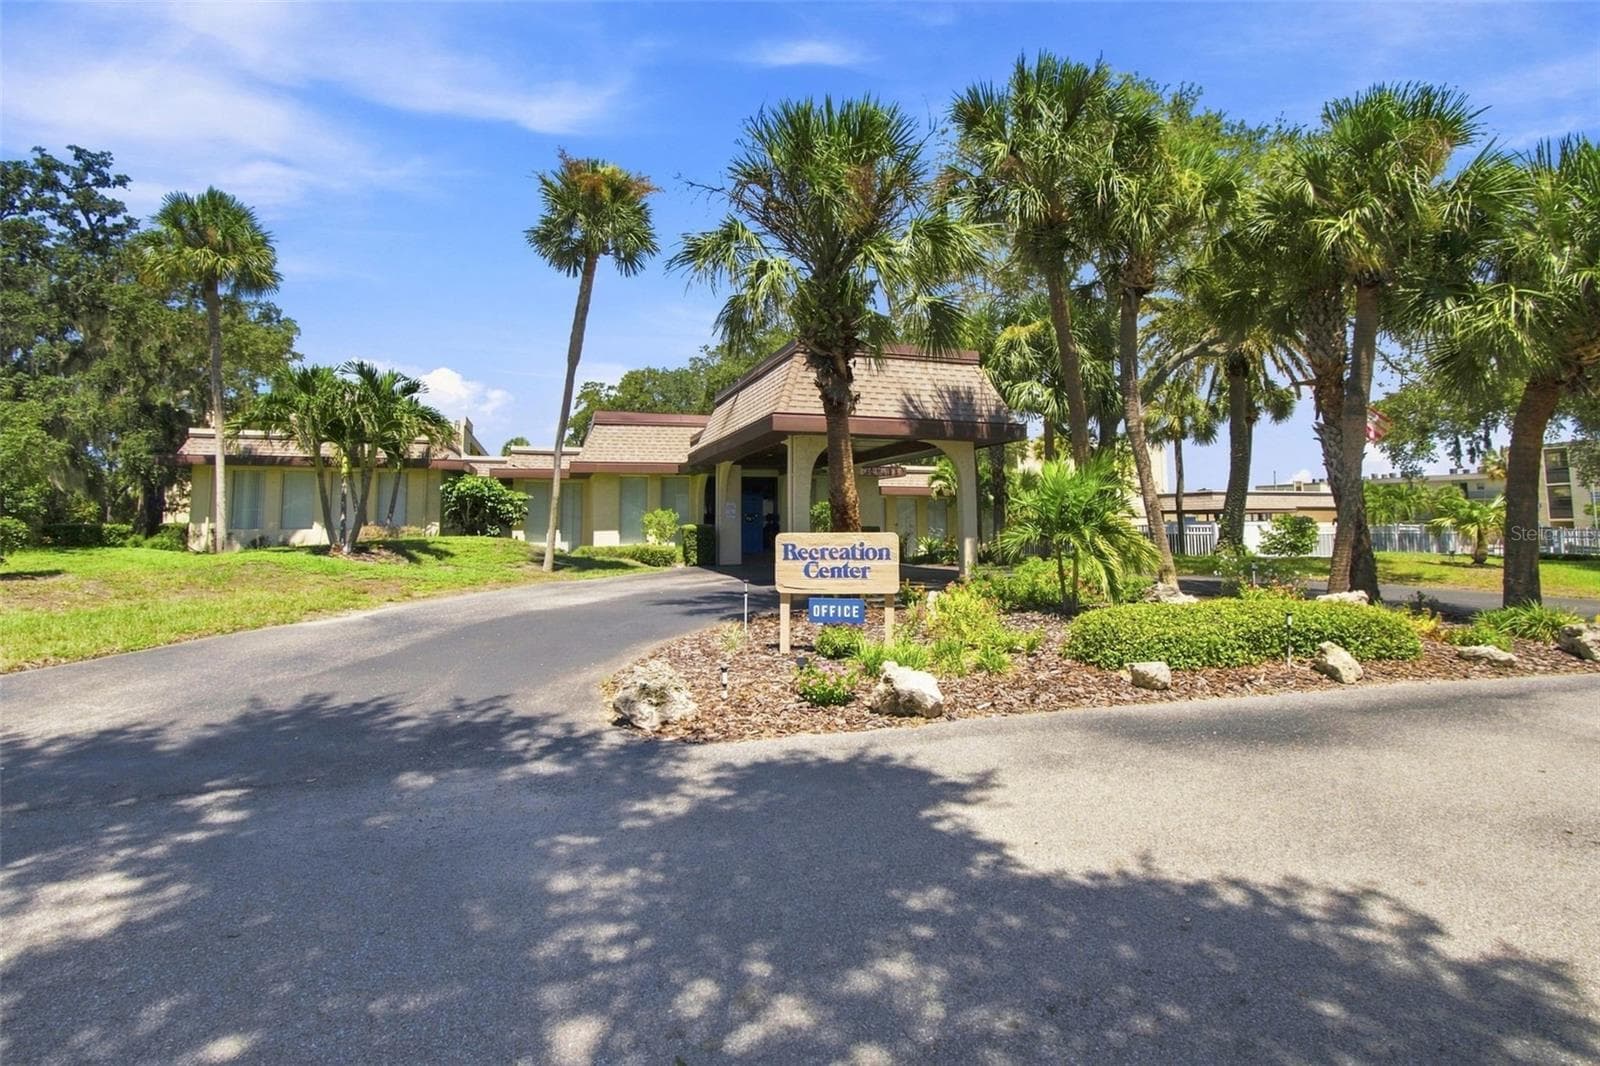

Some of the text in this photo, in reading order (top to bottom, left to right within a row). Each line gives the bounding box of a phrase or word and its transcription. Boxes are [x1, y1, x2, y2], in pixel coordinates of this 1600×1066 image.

[782, 542, 891, 561] Recreation
[803, 561, 871, 579] Center
[813, 605, 859, 617] OFFICE
